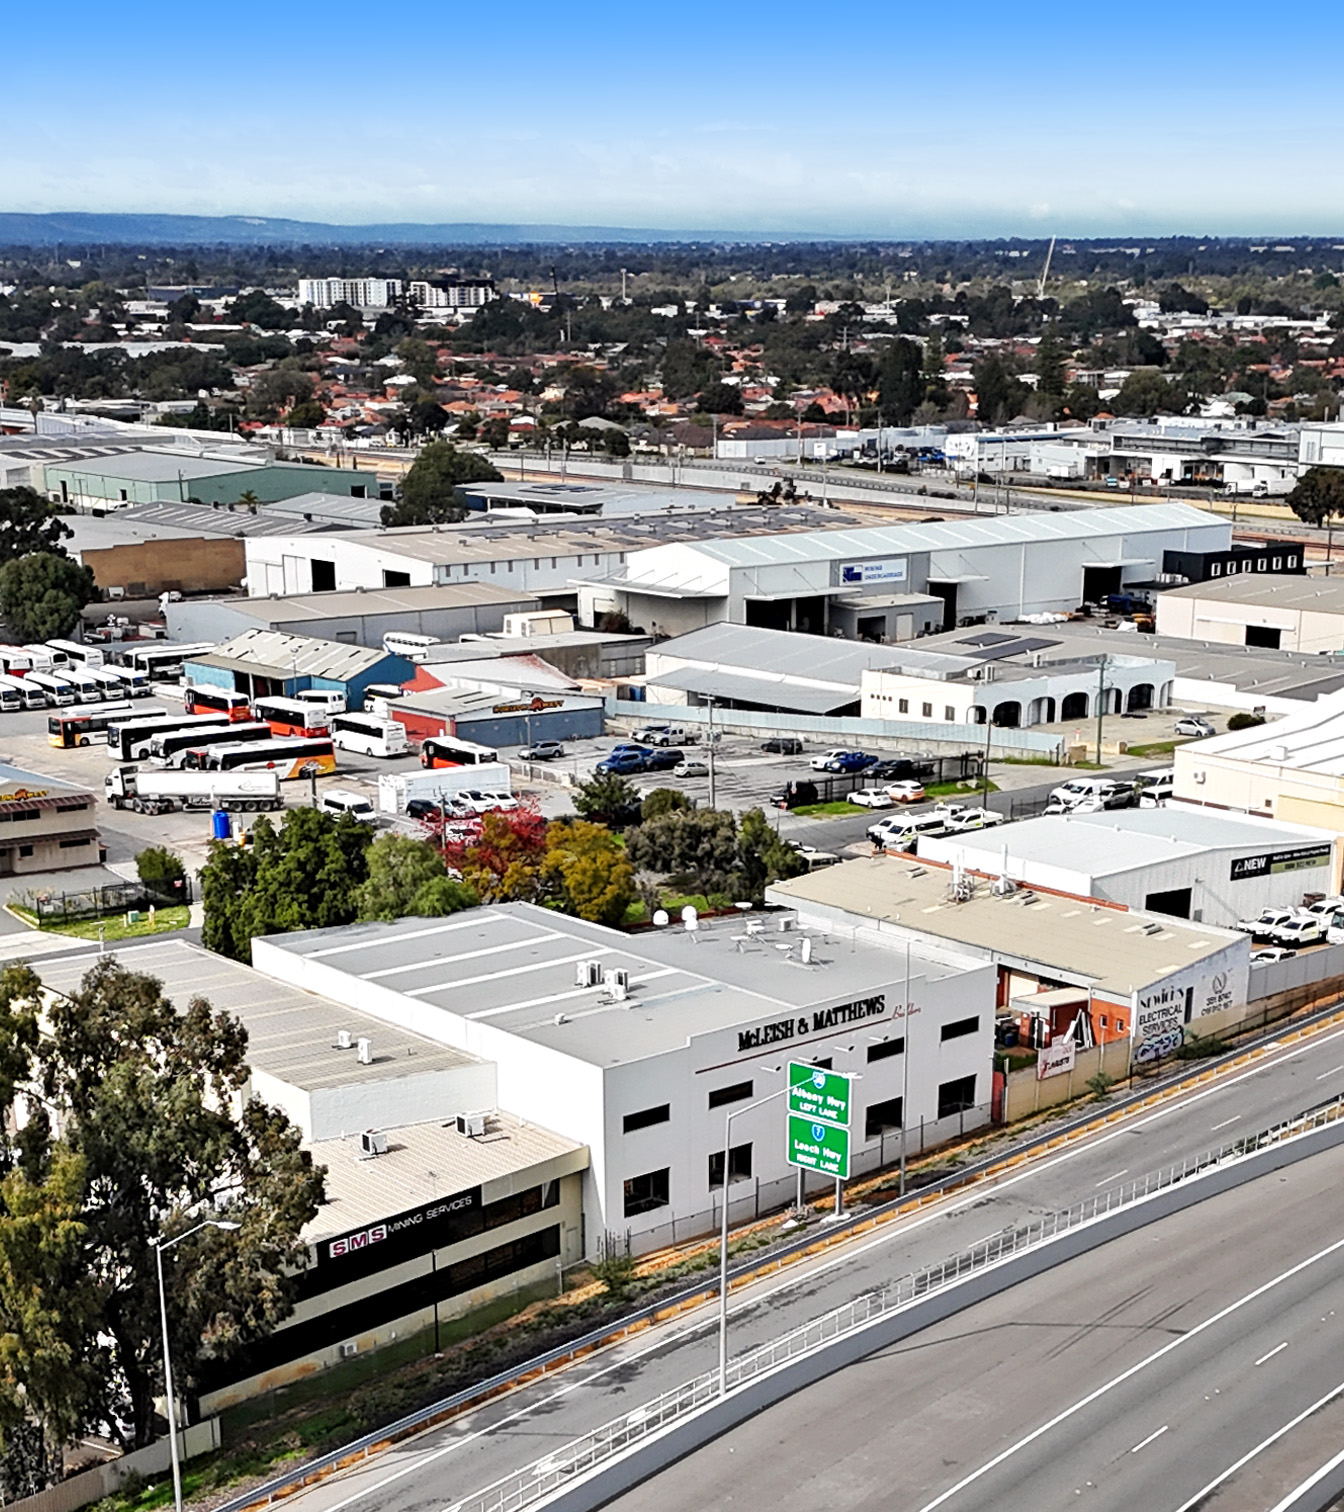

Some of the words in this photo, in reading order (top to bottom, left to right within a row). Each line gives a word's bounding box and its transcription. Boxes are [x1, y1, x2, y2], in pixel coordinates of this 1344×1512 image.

[1244, 857, 1266, 871] NEW
[797, 1017, 809, 1035] &
[812, 995, 886, 1031] MATTHEWS
[1139, 1004, 1182, 1025] ELECTRICAL
[792, 1087, 824, 1105] Albany
[827, 1095, 846, 1111] Hwy
[799, 1102, 817, 1112] LEFT
[818, 1107, 838, 1119] LANE
[796, 1153, 817, 1166] RIGHT
[819, 1160, 839, 1172] LANE
[822, 1147, 842, 1163] Hwy
[331, 1226, 386, 1257] SMS
[387, 1213, 424, 1233] MINING
[426, 1196, 472, 1220] SERVICES
